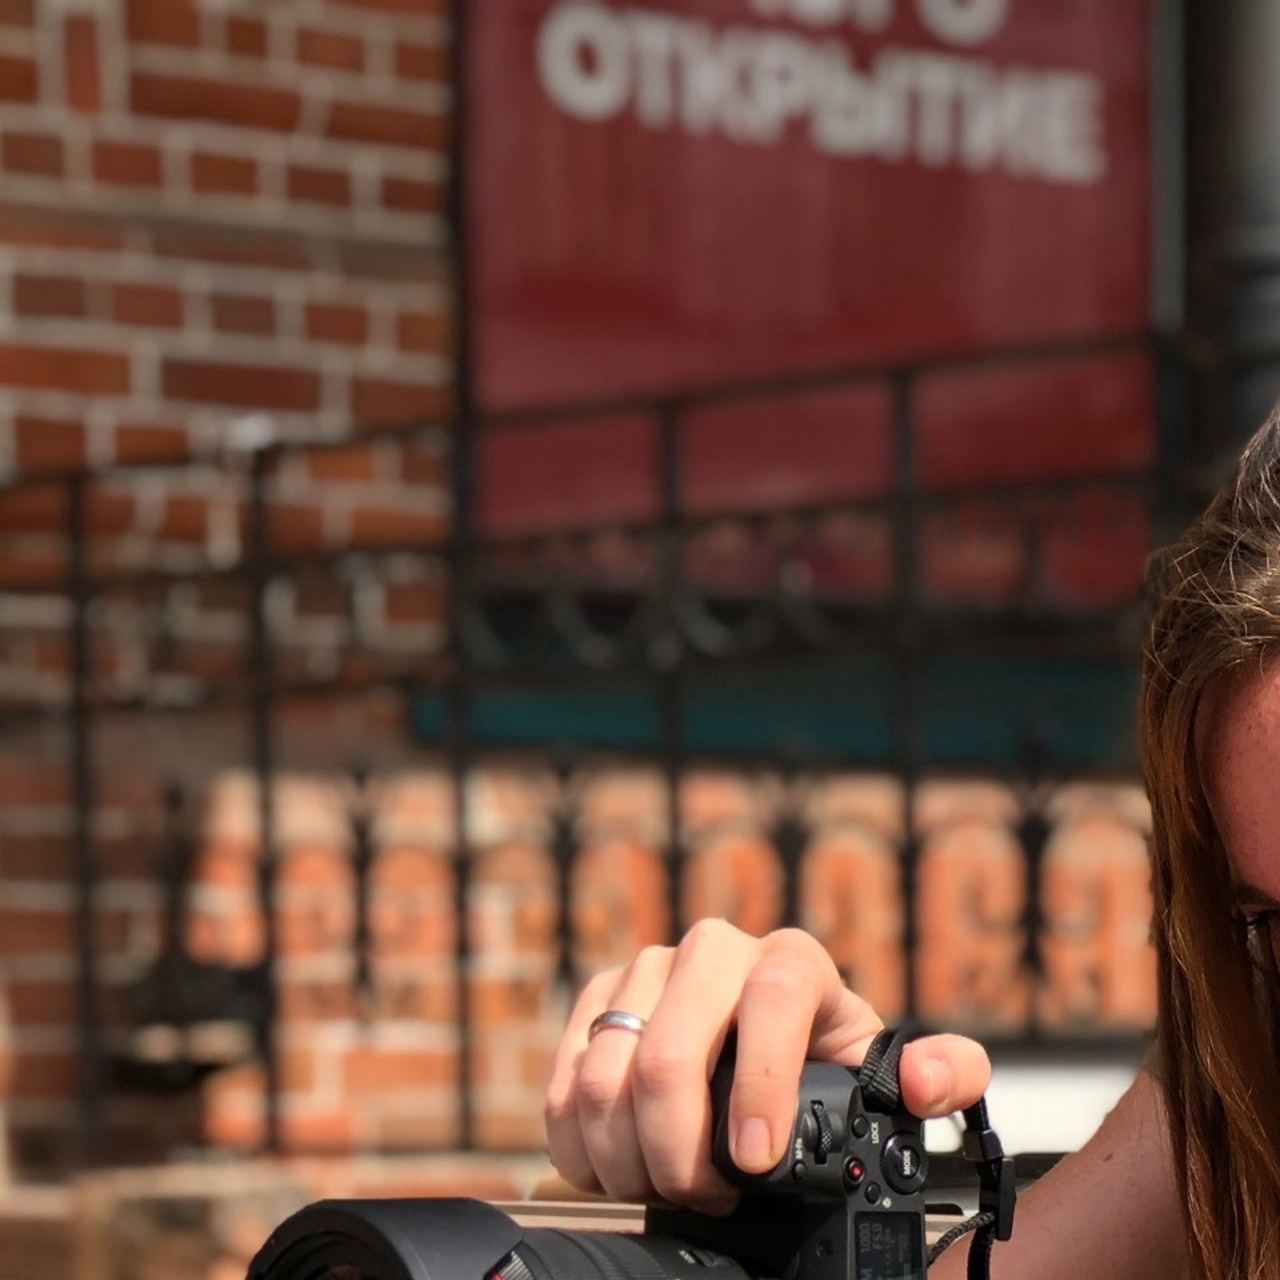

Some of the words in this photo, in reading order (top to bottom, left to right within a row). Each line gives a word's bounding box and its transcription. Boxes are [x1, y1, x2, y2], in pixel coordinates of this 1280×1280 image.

[537, 3, 1107, 184] ОТКРЫТИЕ
[870, 1122, 880, 1144] LOCK
[903, 1150, 912, 1175] MODE
